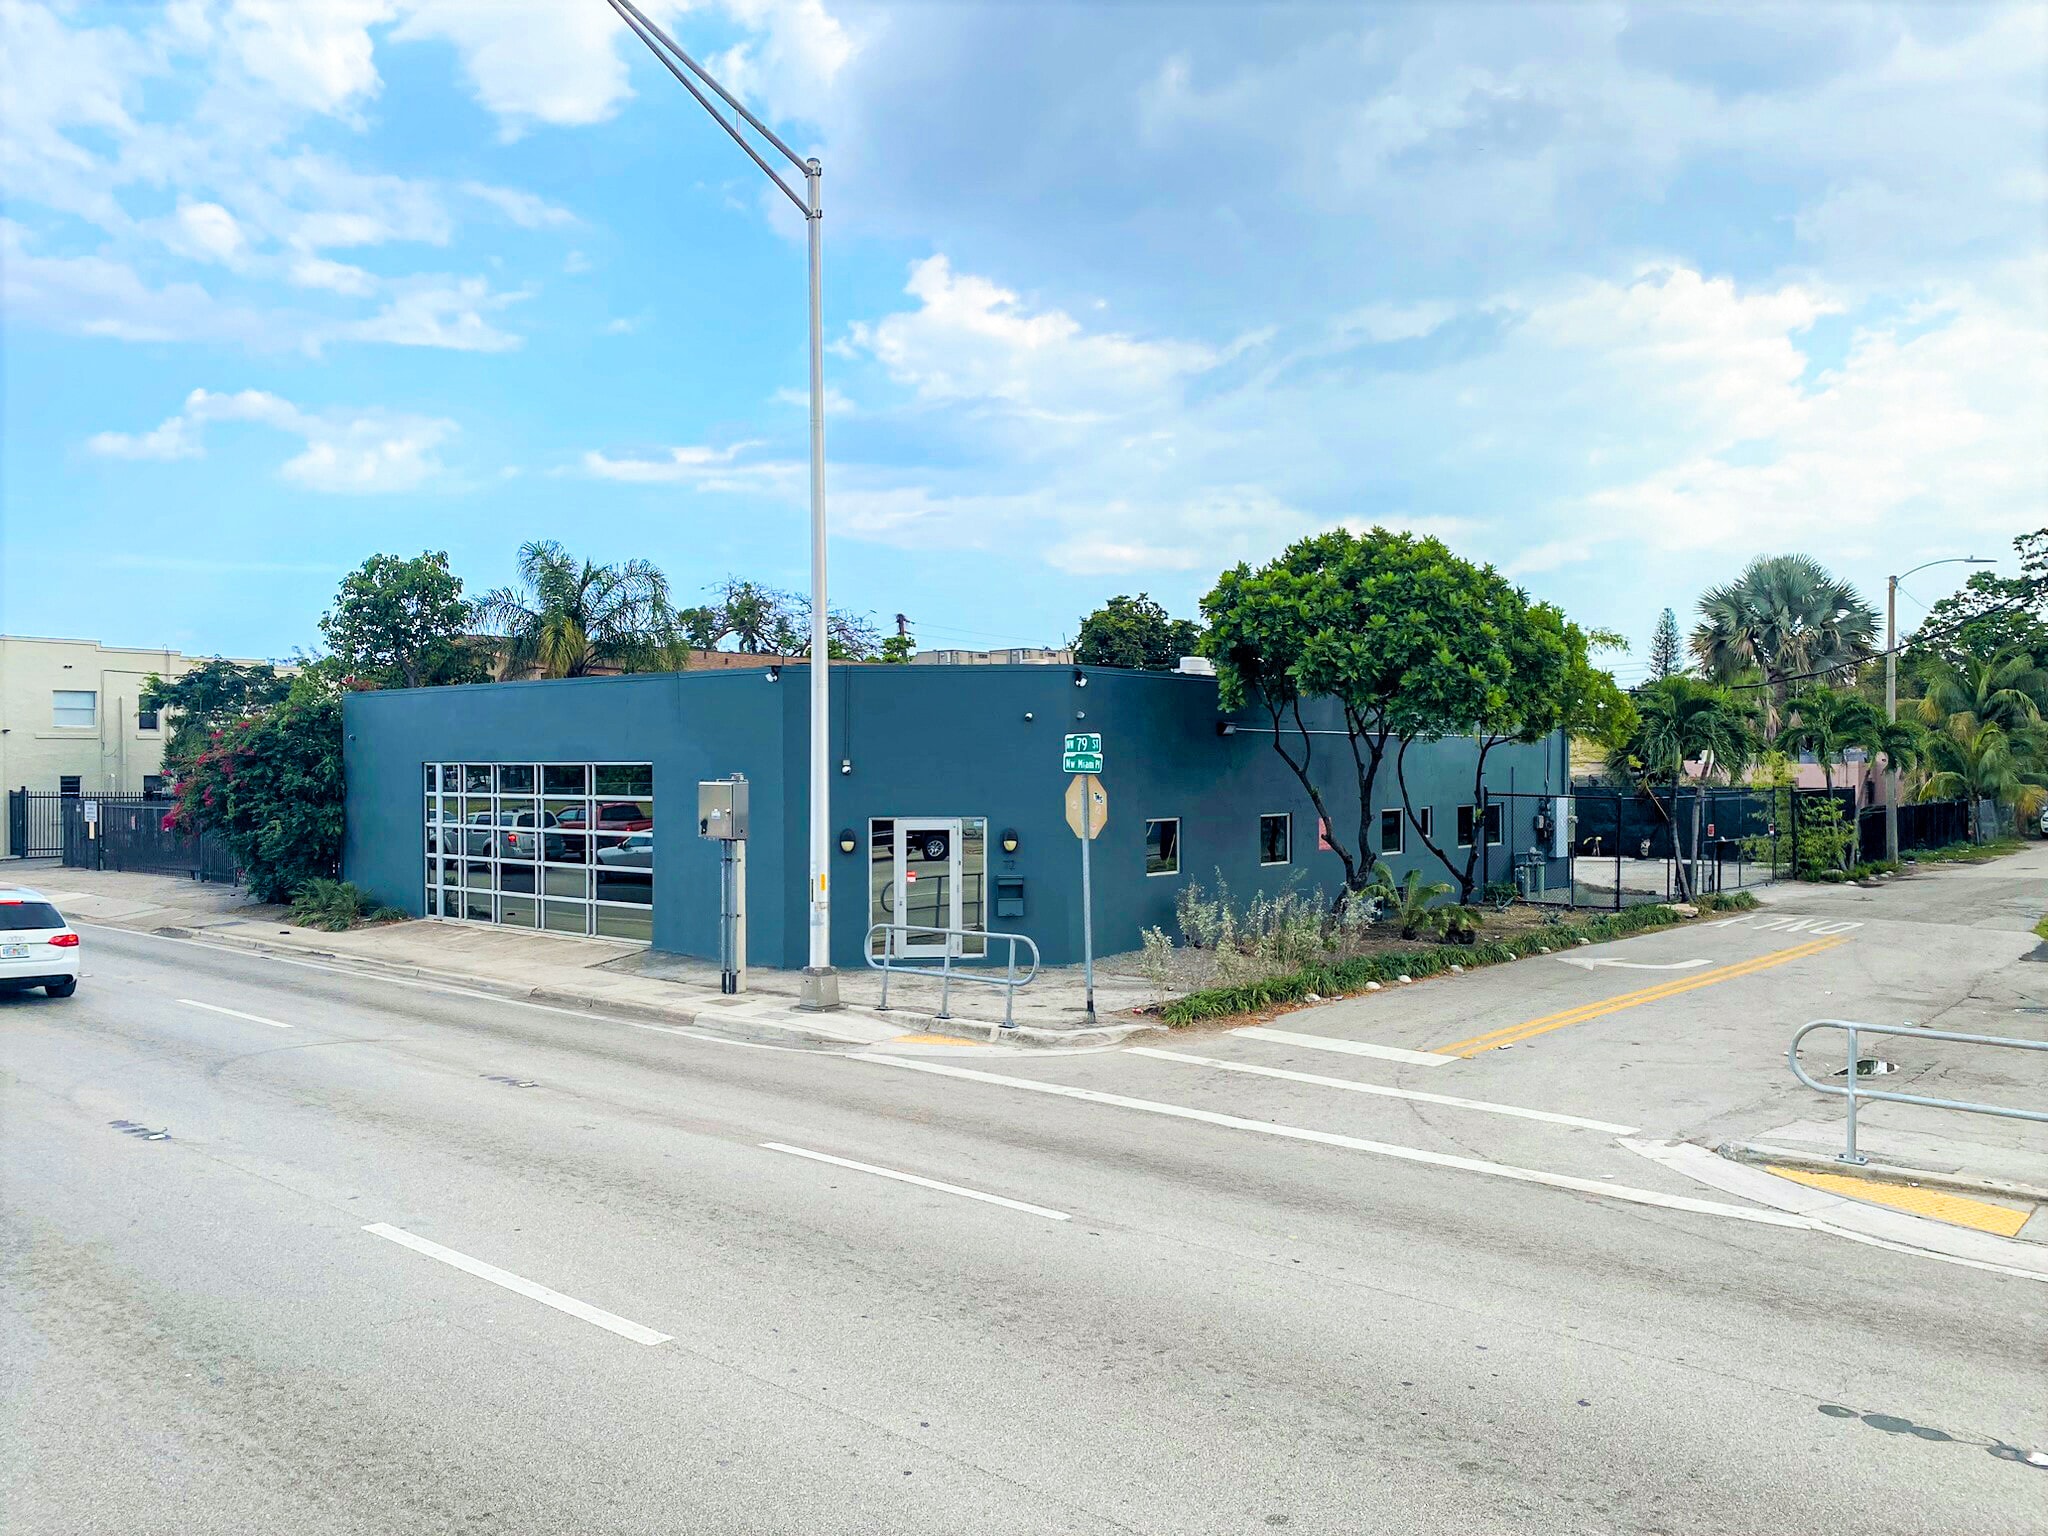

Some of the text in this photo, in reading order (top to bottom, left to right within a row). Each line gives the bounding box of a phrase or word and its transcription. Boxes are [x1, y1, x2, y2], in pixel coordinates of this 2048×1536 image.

[1077, 737, 1088, 751] 79
[1078, 759, 1095, 769] Miami
[1703, 915, 1865, 935] ONLY
